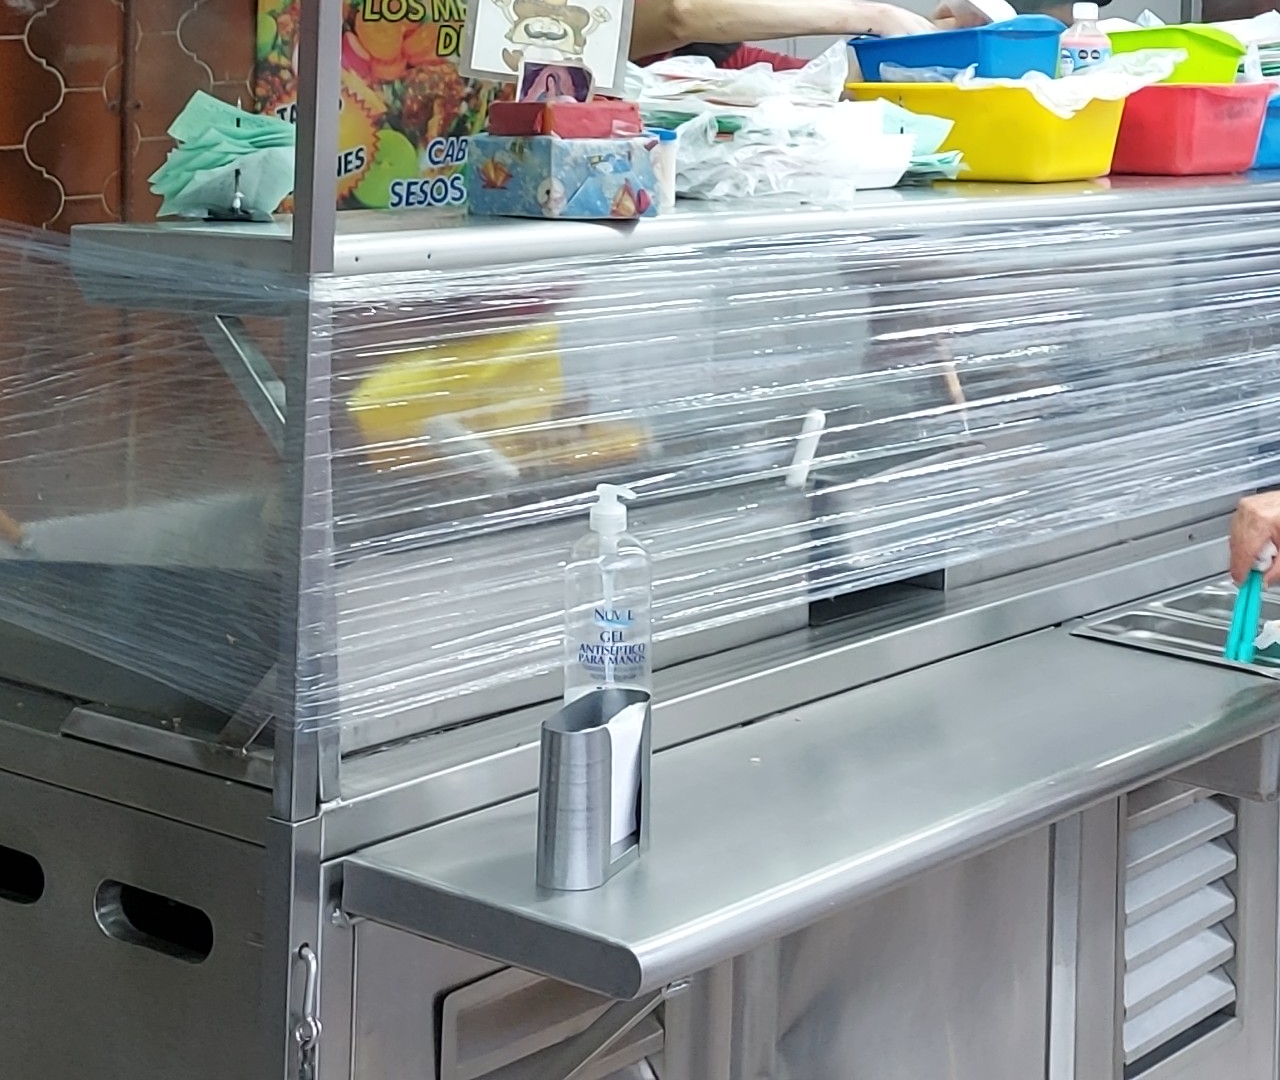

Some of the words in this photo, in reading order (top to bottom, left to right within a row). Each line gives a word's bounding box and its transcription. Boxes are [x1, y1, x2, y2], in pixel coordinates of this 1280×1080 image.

[390, 176, 465, 208] SESOS
[600, 630, 625, 644] GEL
[578, 653, 605, 666] PARA
